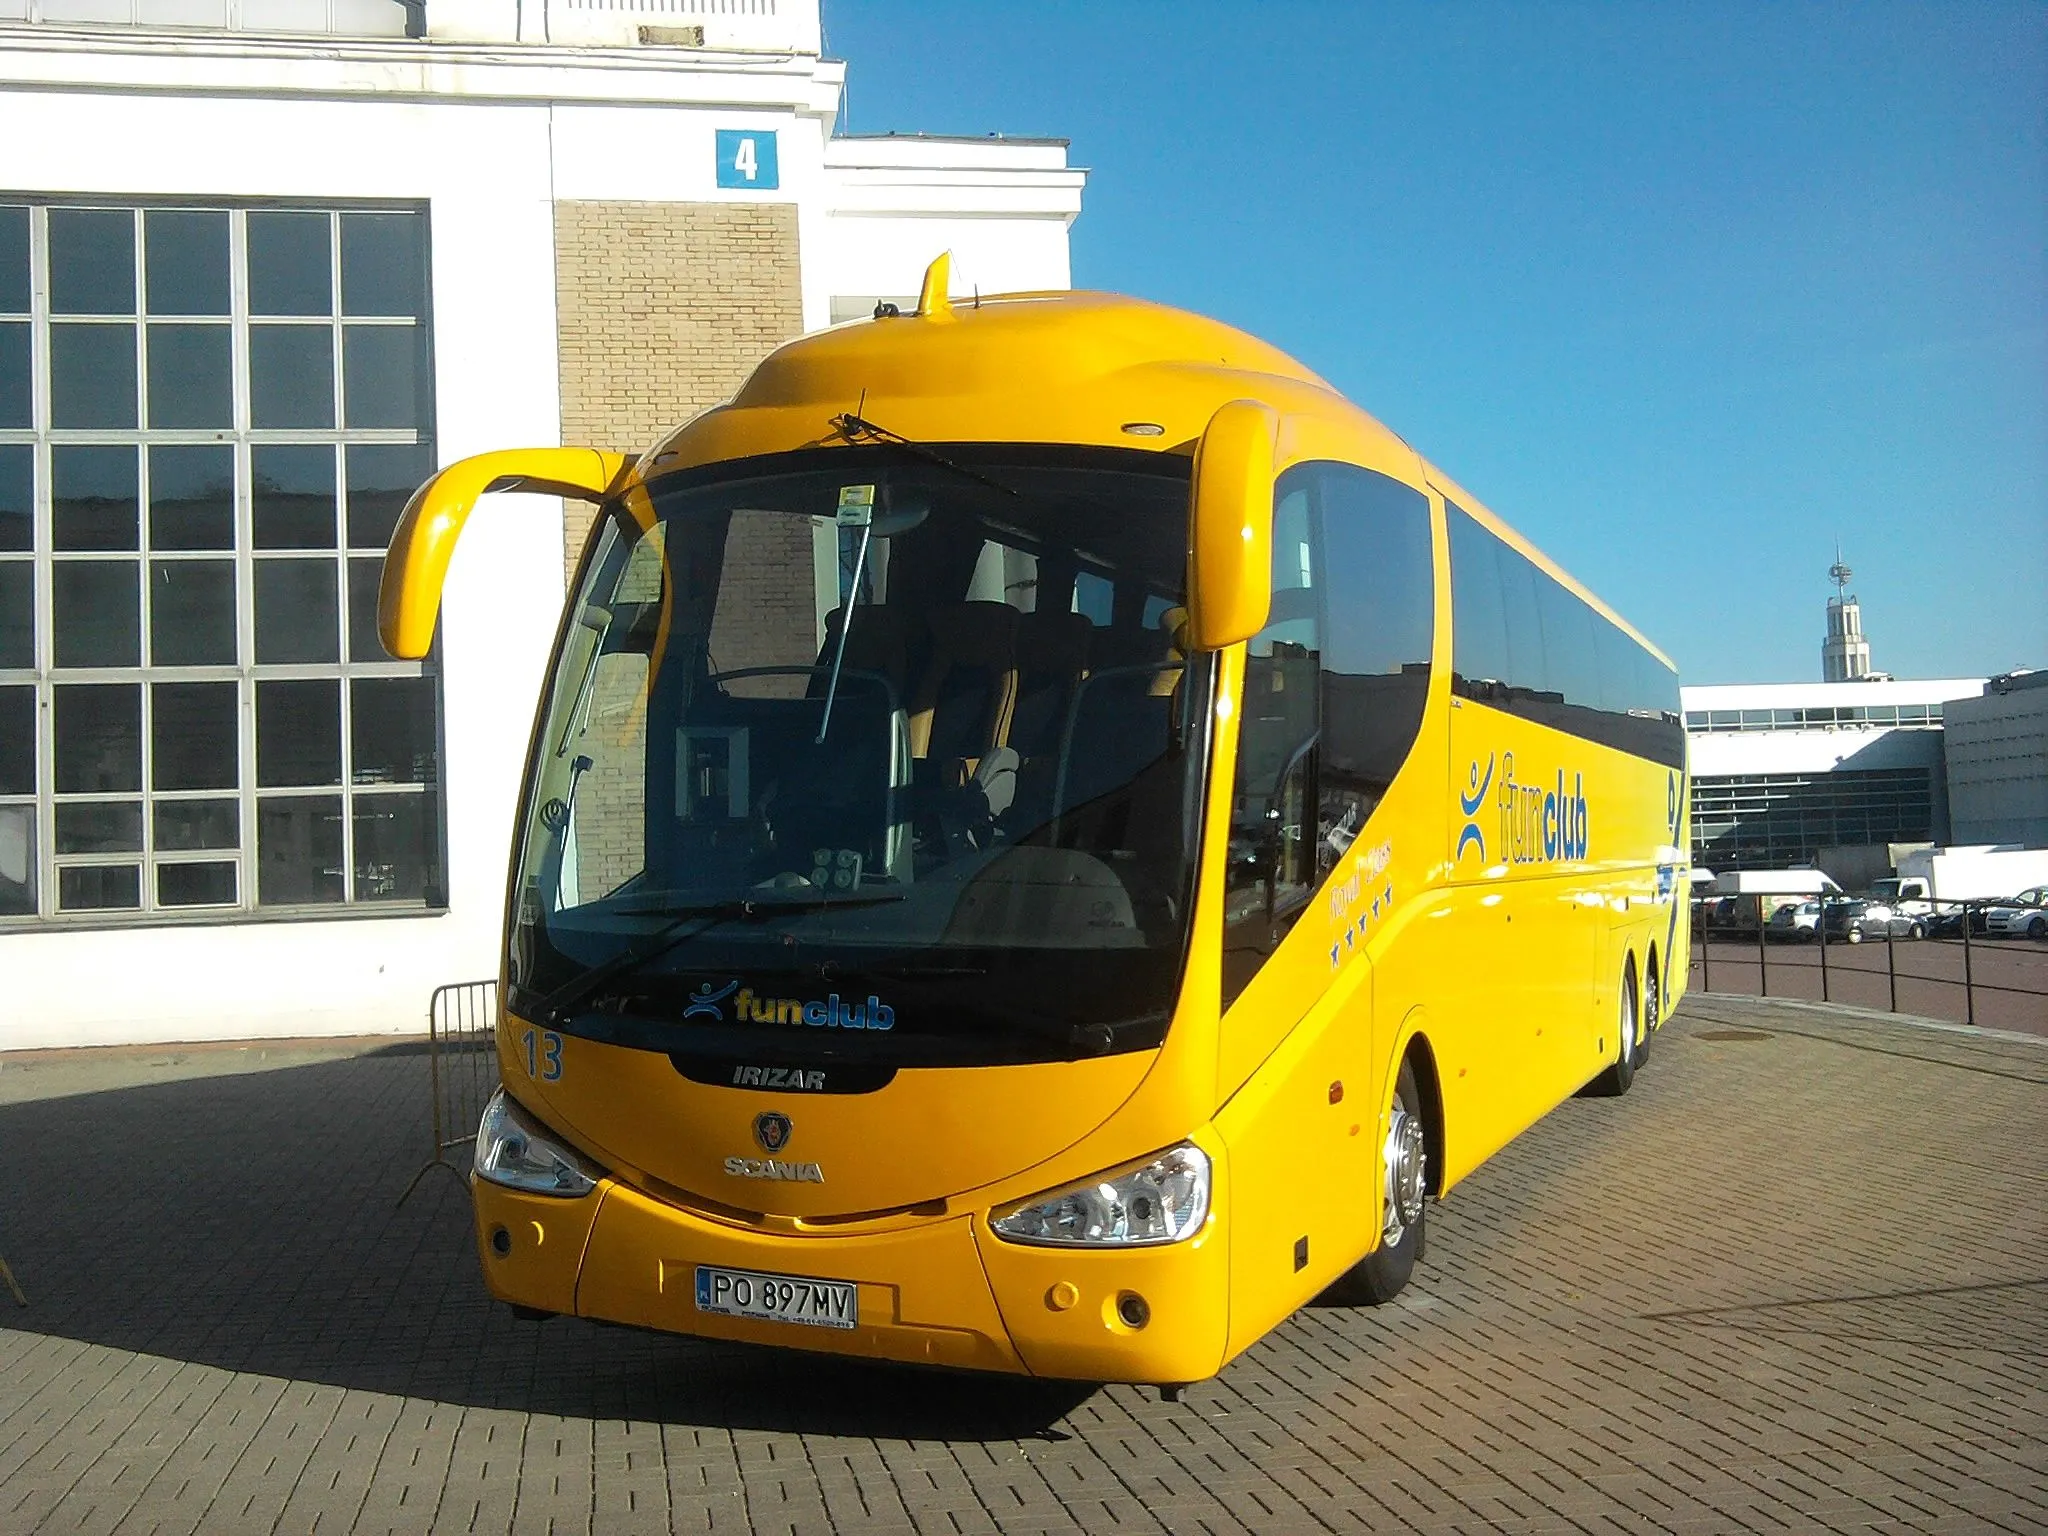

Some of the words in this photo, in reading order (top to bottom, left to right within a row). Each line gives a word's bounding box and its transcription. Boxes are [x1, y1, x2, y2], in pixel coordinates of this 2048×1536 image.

[734, 137, 758, 181] 4
[1498, 750, 1588, 864] funclub
[734, 986, 895, 1031] funclub
[521, 1029, 563, 1082] 13
[732, 1065, 826, 1090] IRIZAR
[724, 1156, 825, 1184] SCANIA
[714, 1274, 754, 1307] PO
[763, 1280, 849, 1319] 897MV
